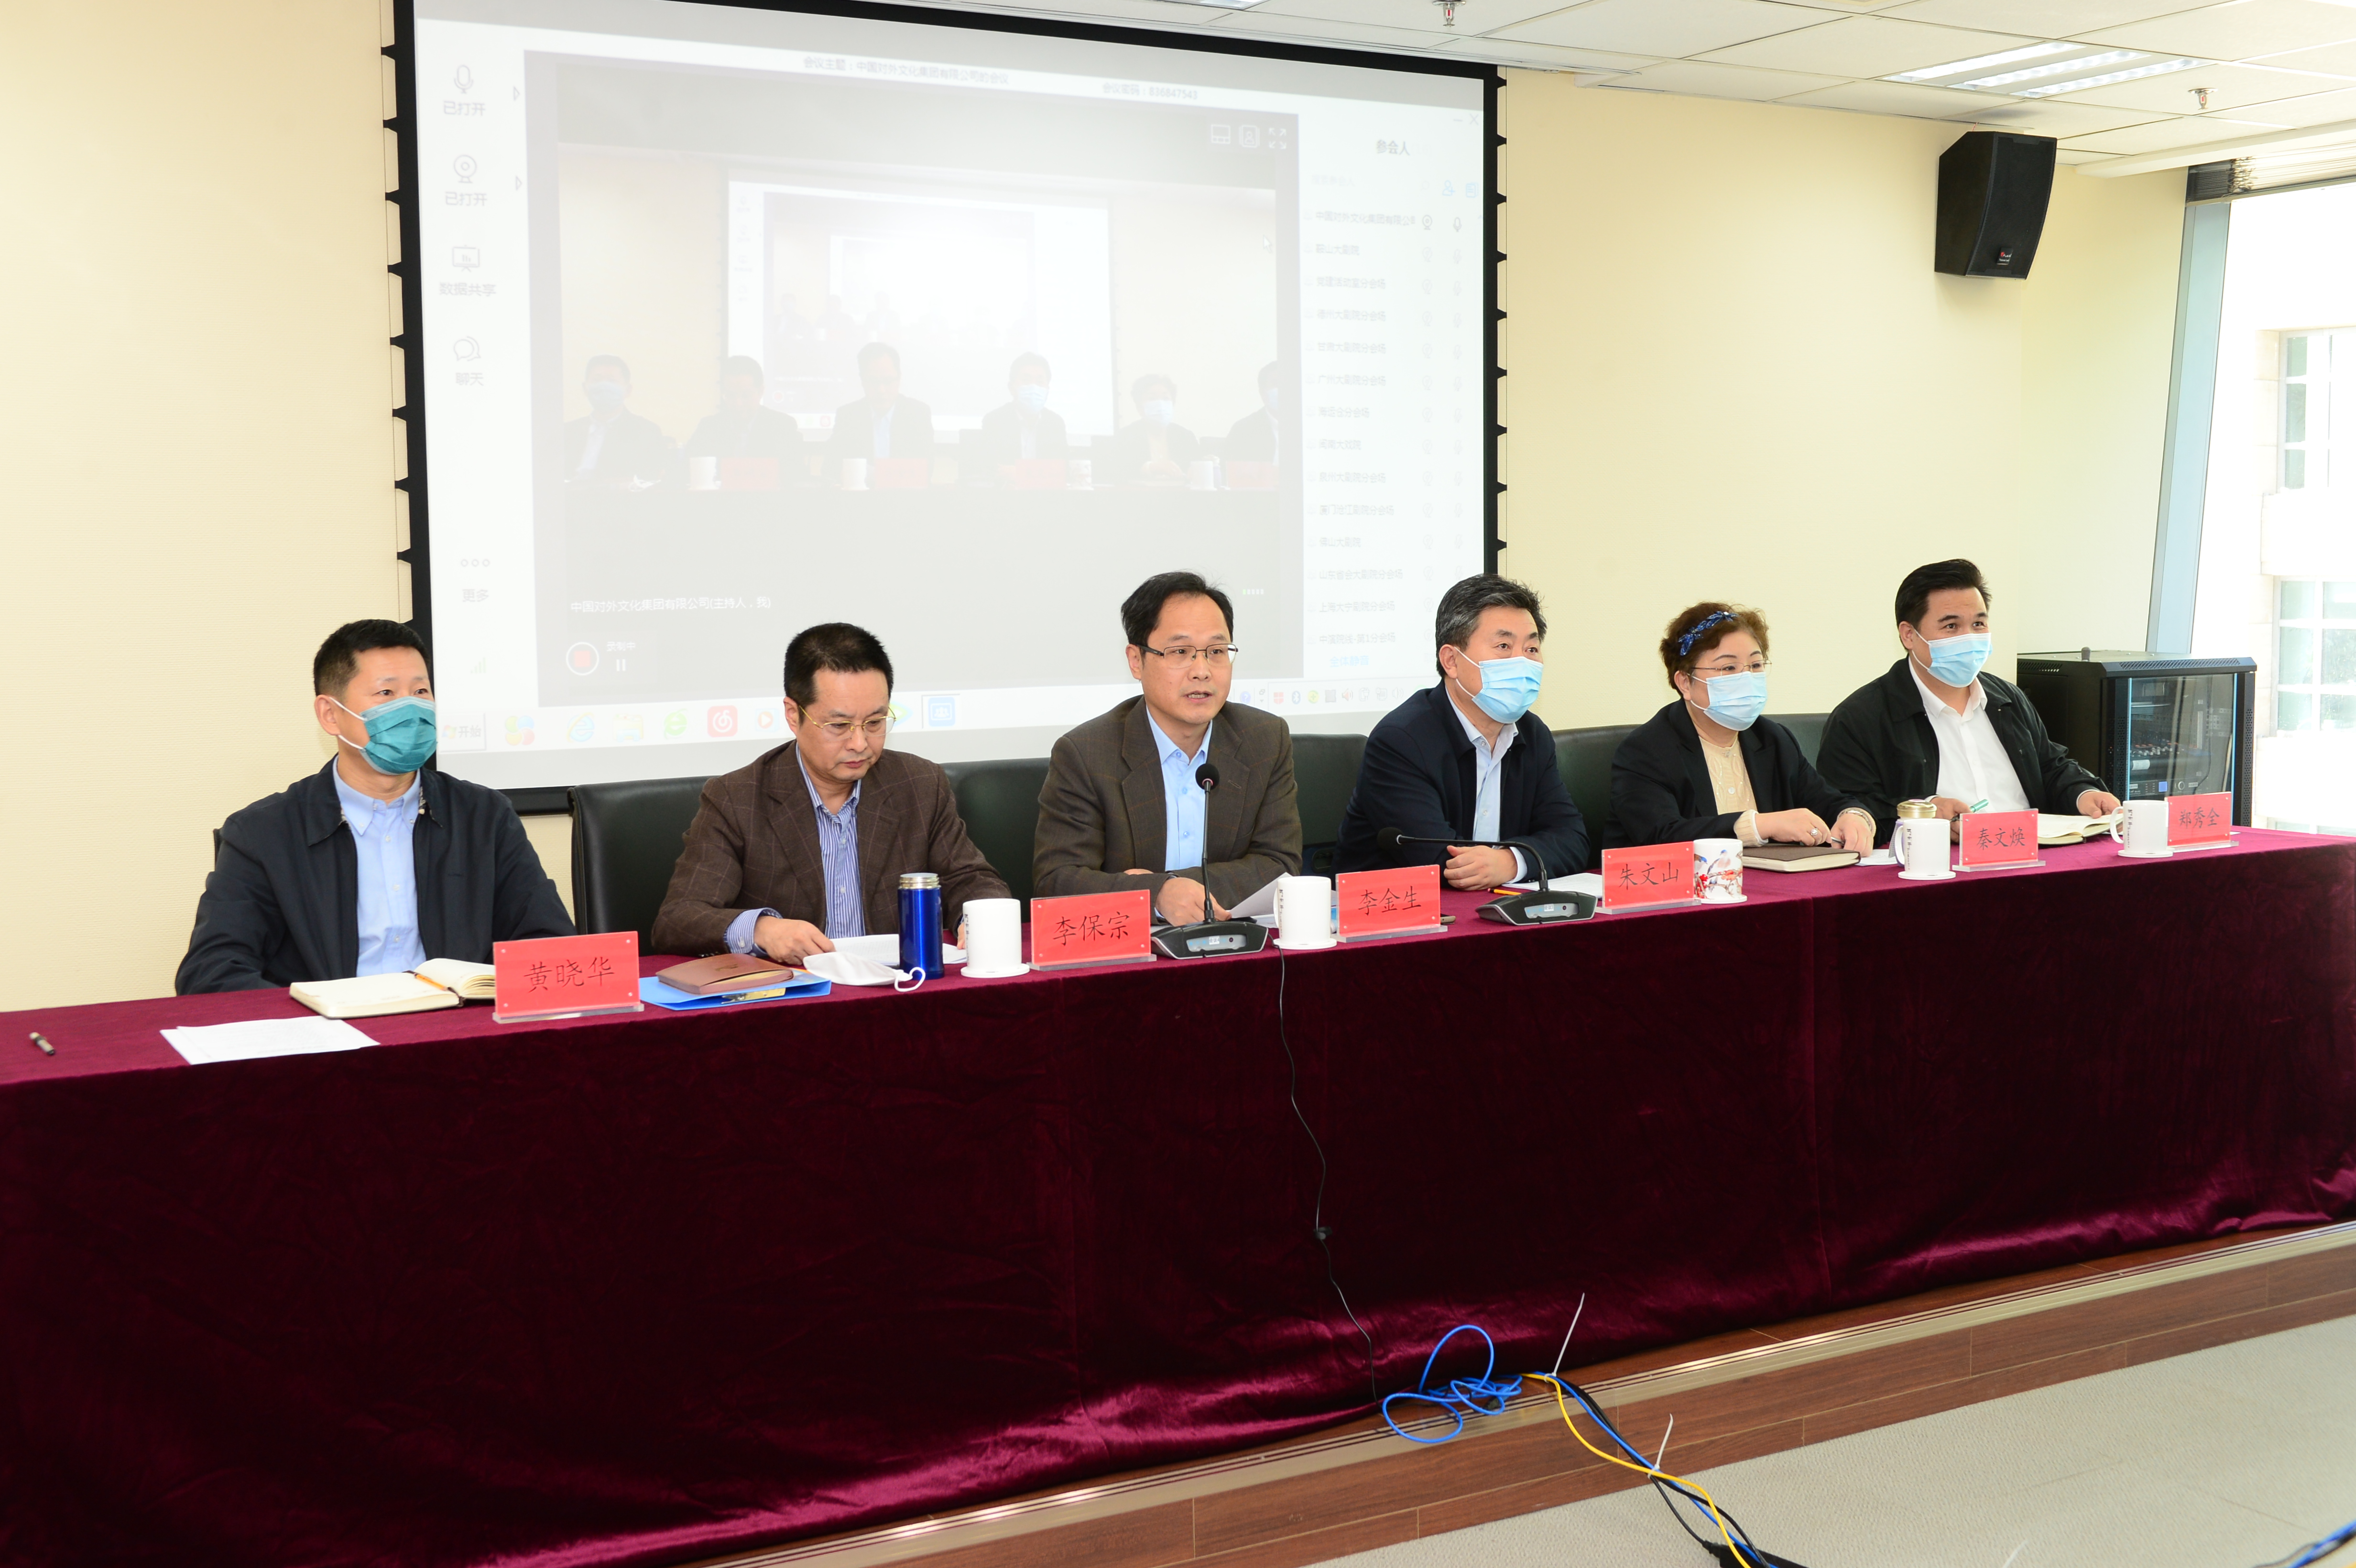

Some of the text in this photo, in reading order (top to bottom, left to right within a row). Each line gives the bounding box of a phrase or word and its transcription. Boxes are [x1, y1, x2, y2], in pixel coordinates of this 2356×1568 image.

[444, 100, 486, 116] 已打开
[1376, 139, 1410, 156] 参会人
[446, 191, 488, 207] 已打开
[439, 282, 496, 297] 数据共享
[456, 372, 484, 386] 聊天
[462, 589, 489, 602] 更多
[607, 642, 636, 652] 录制中
[1330, 655, 1369, 668] 全体静音
[458, 725, 481, 738] 开始
[2179, 806, 2220, 829] 郑秀全
[1977, 827, 2026, 850] 秦文焕
[1619, 862, 1679, 890] 朱文山
[1358, 886, 1422, 916] 李金生
[1053, 911, 1130, 946] 李保宗
[524, 957, 615, 993] 黄晓华
